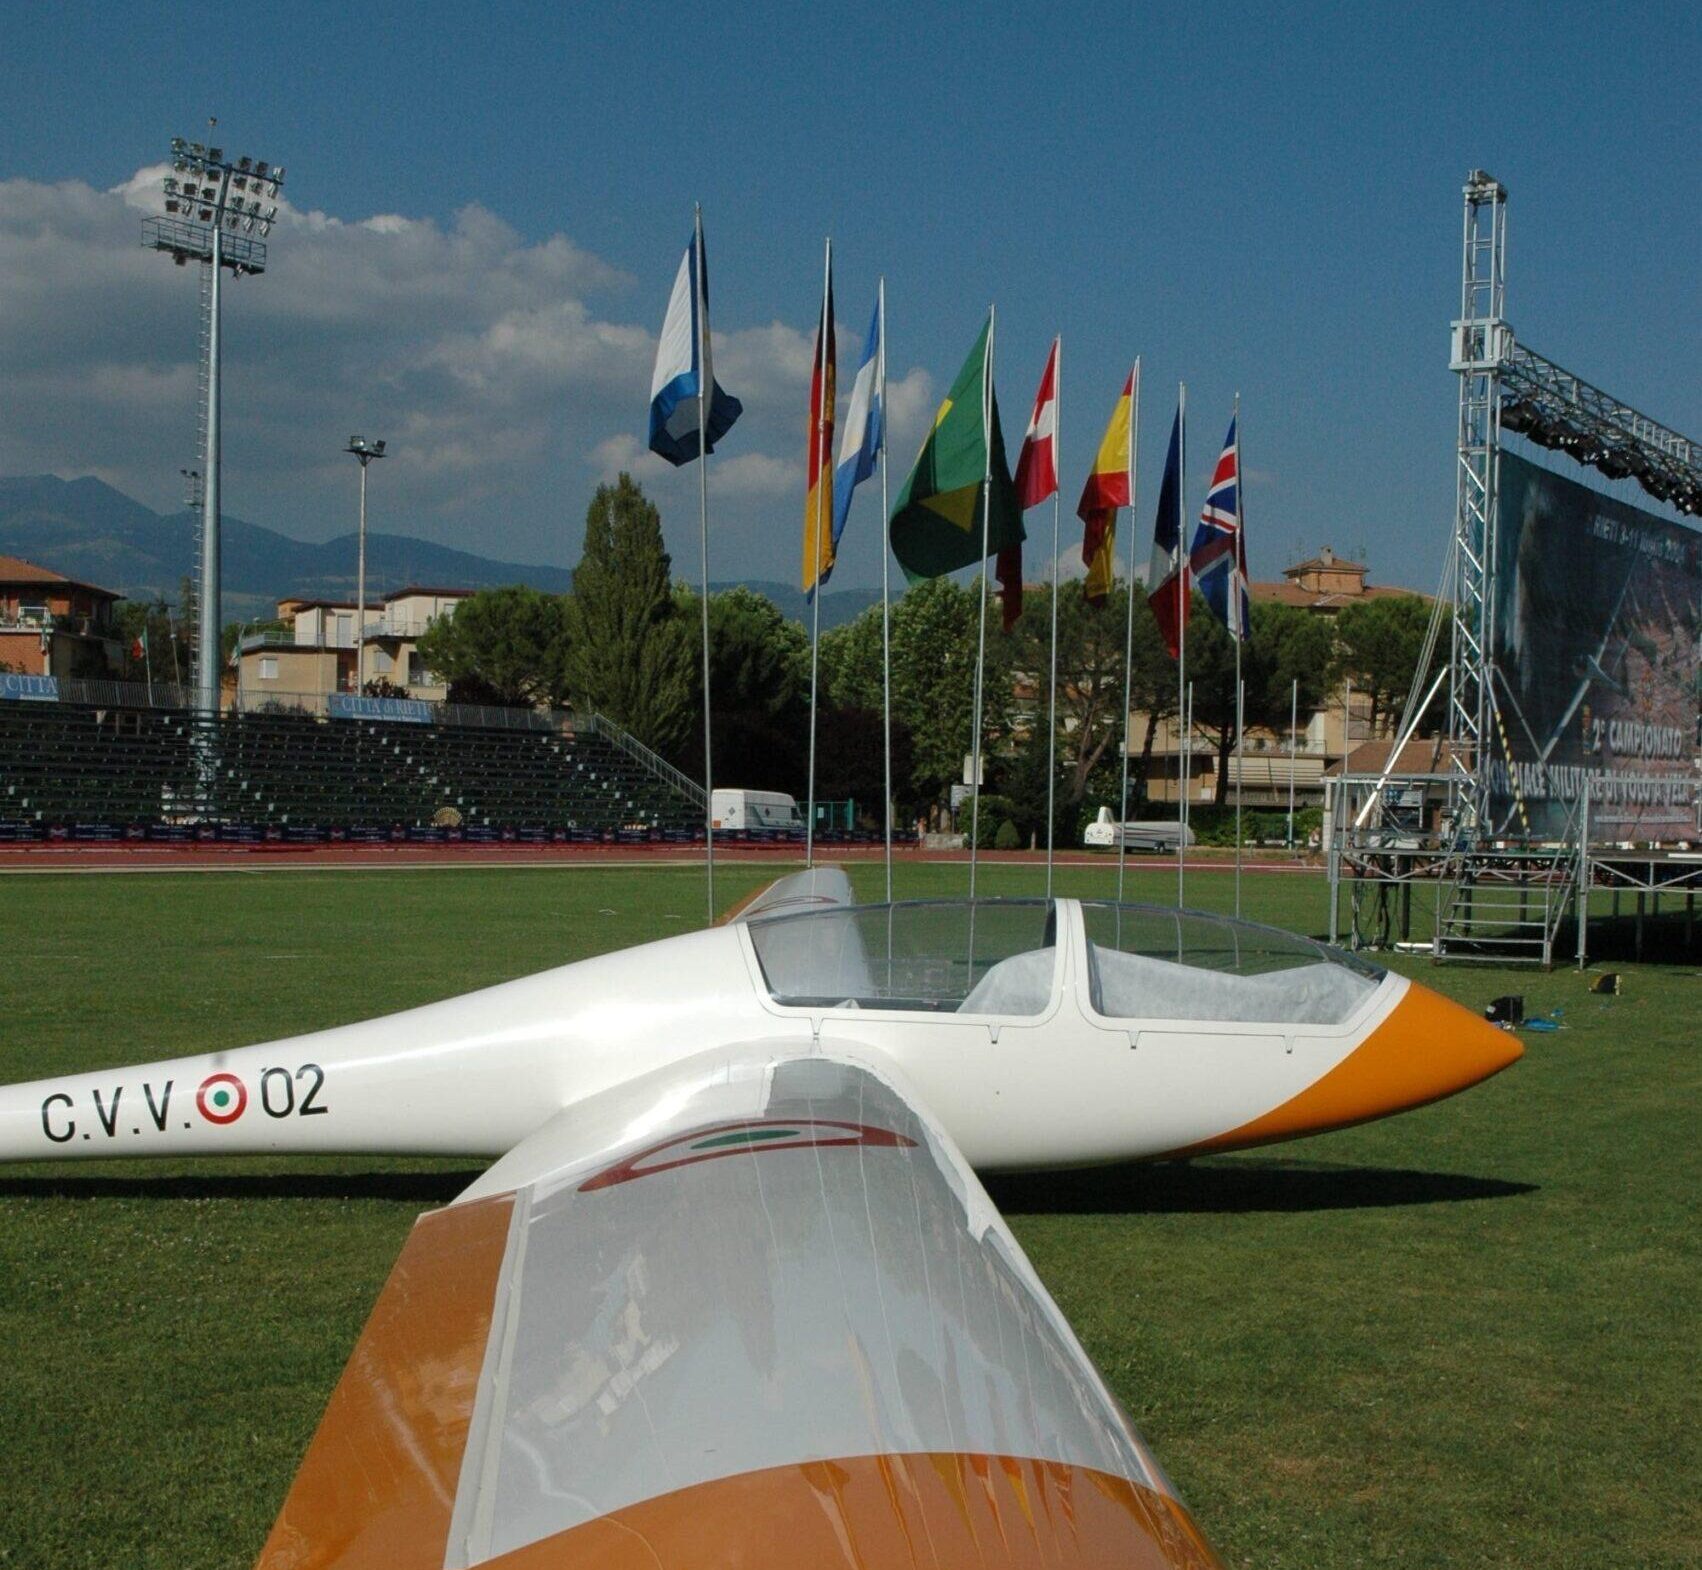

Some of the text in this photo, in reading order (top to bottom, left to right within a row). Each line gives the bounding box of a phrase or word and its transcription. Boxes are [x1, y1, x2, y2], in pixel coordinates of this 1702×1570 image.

[1609, 720, 1682, 755] CAMPIONATO
[41, 1063, 329, 1143] C.V.V. 02
